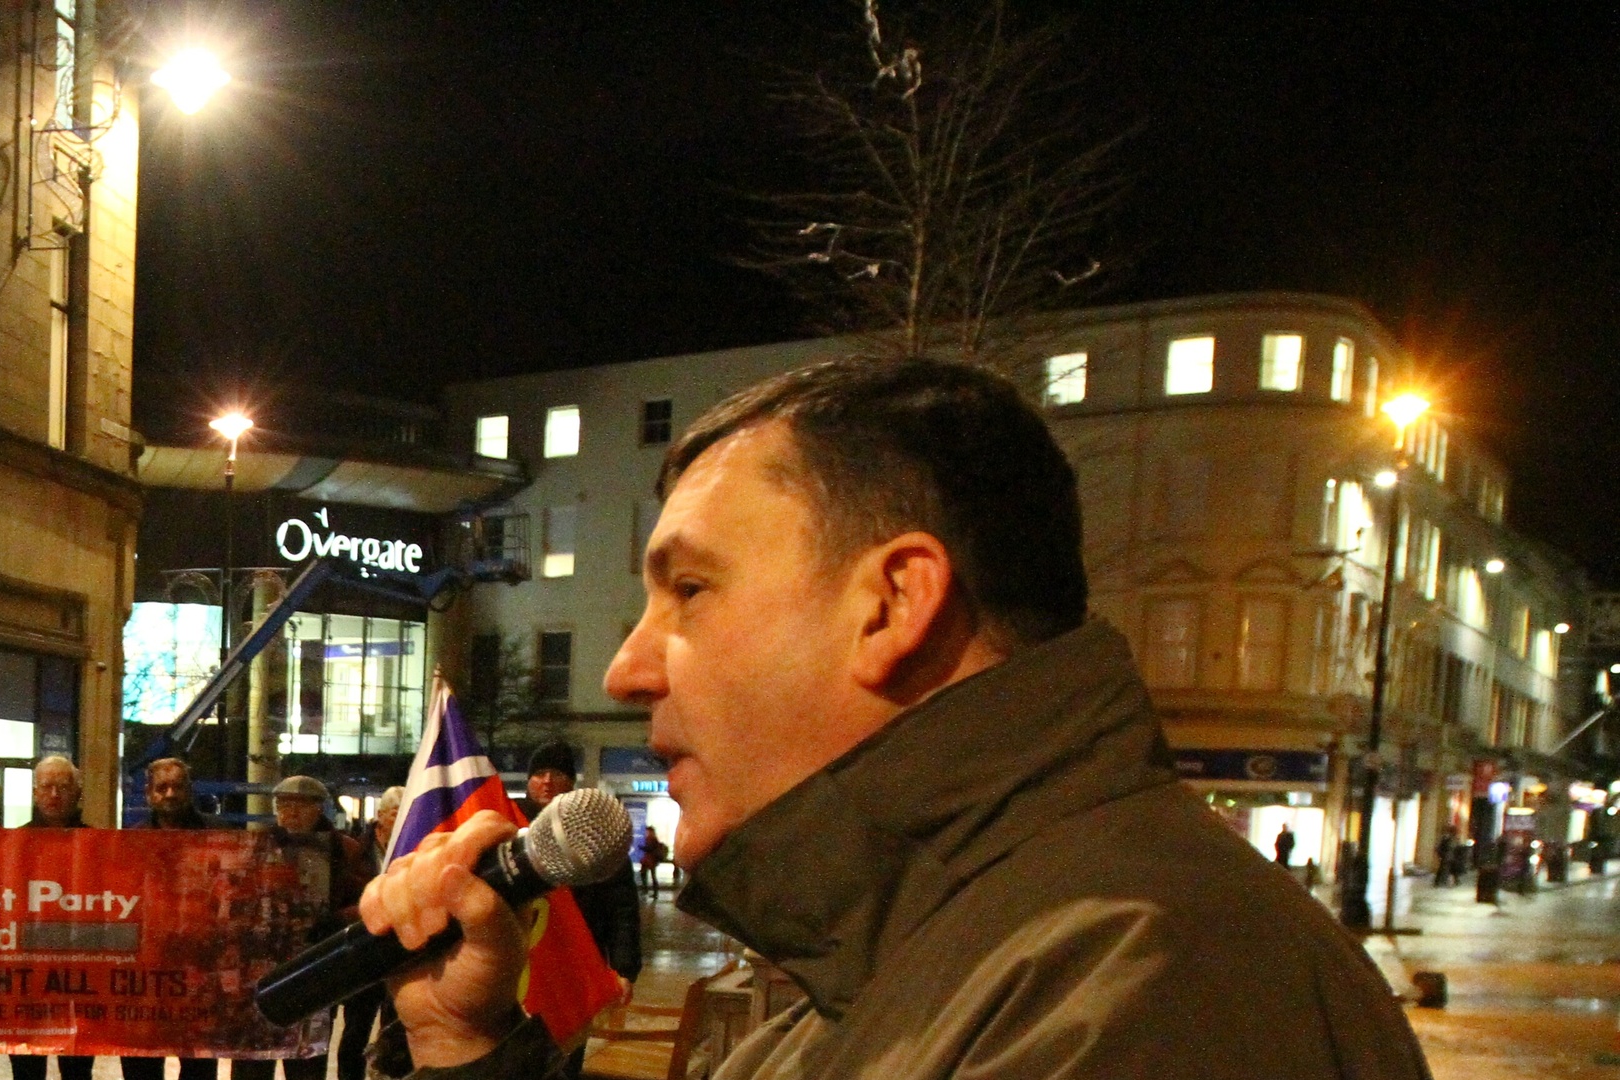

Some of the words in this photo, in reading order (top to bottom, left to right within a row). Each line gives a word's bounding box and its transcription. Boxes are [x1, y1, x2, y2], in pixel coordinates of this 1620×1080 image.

[276, 510, 424, 578] Overgate
[28, 880, 140, 920] Party
[45, 969, 96, 996] ALL
[109, 969, 187, 999] CUTS
